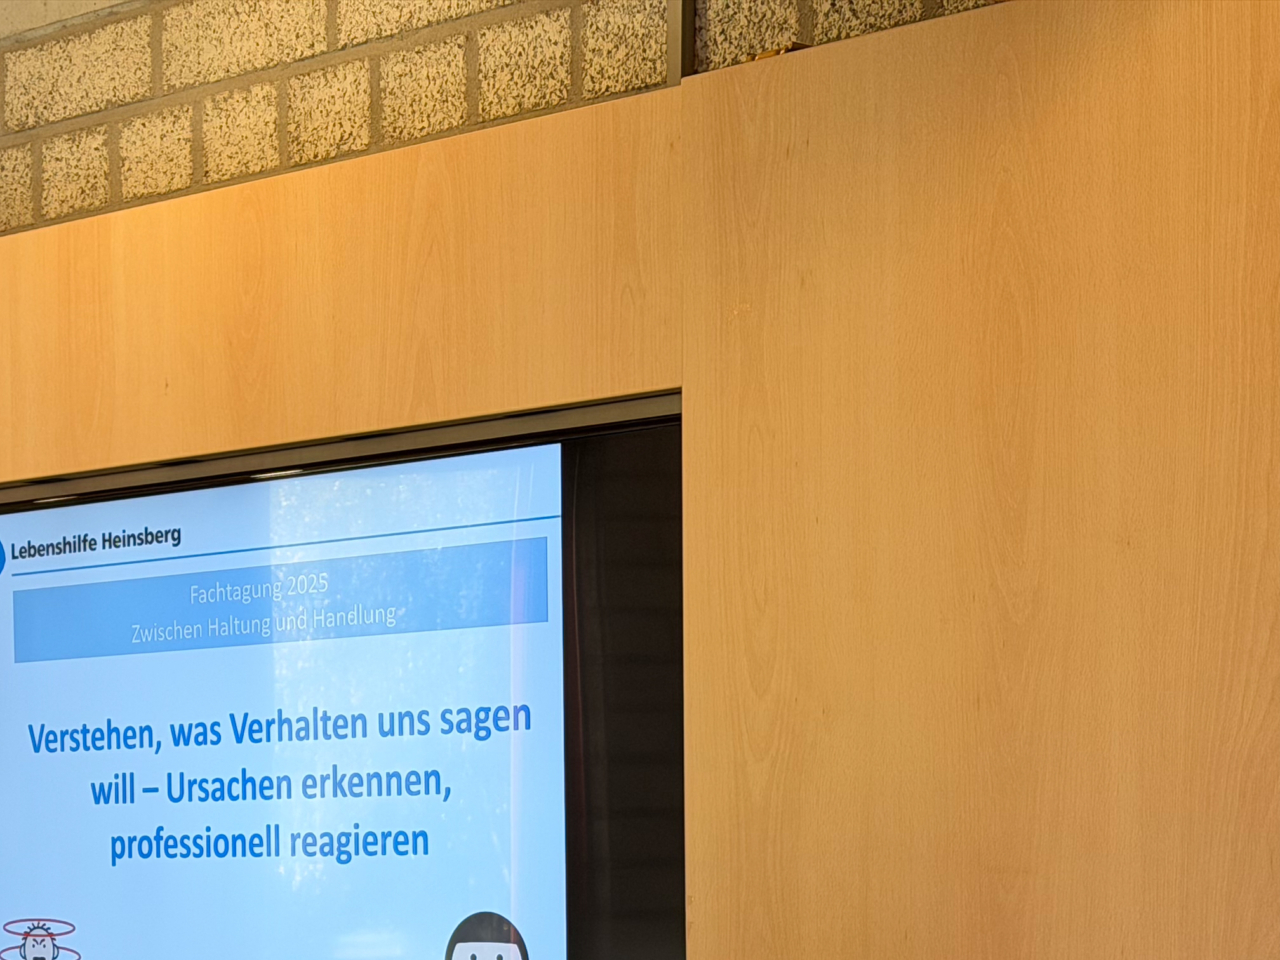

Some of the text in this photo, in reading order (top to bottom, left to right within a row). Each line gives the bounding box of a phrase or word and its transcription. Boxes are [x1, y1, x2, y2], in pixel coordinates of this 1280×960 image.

[11, 526, 181, 560] Lebenshilfe Heinsberg
[190, 572, 329, 605] Fachtagung 2025
[131, 603, 397, 644] Zwischen Haltung und Handlung
[28, 704, 531, 755] Verstehen, was Verhalten uns sagen
[90, 771, 135, 805] will
[167, 767, 292, 803] Ursachen
[302, 764, 451, 803] erkennen,
[111, 822, 429, 867] professionell reagieren
